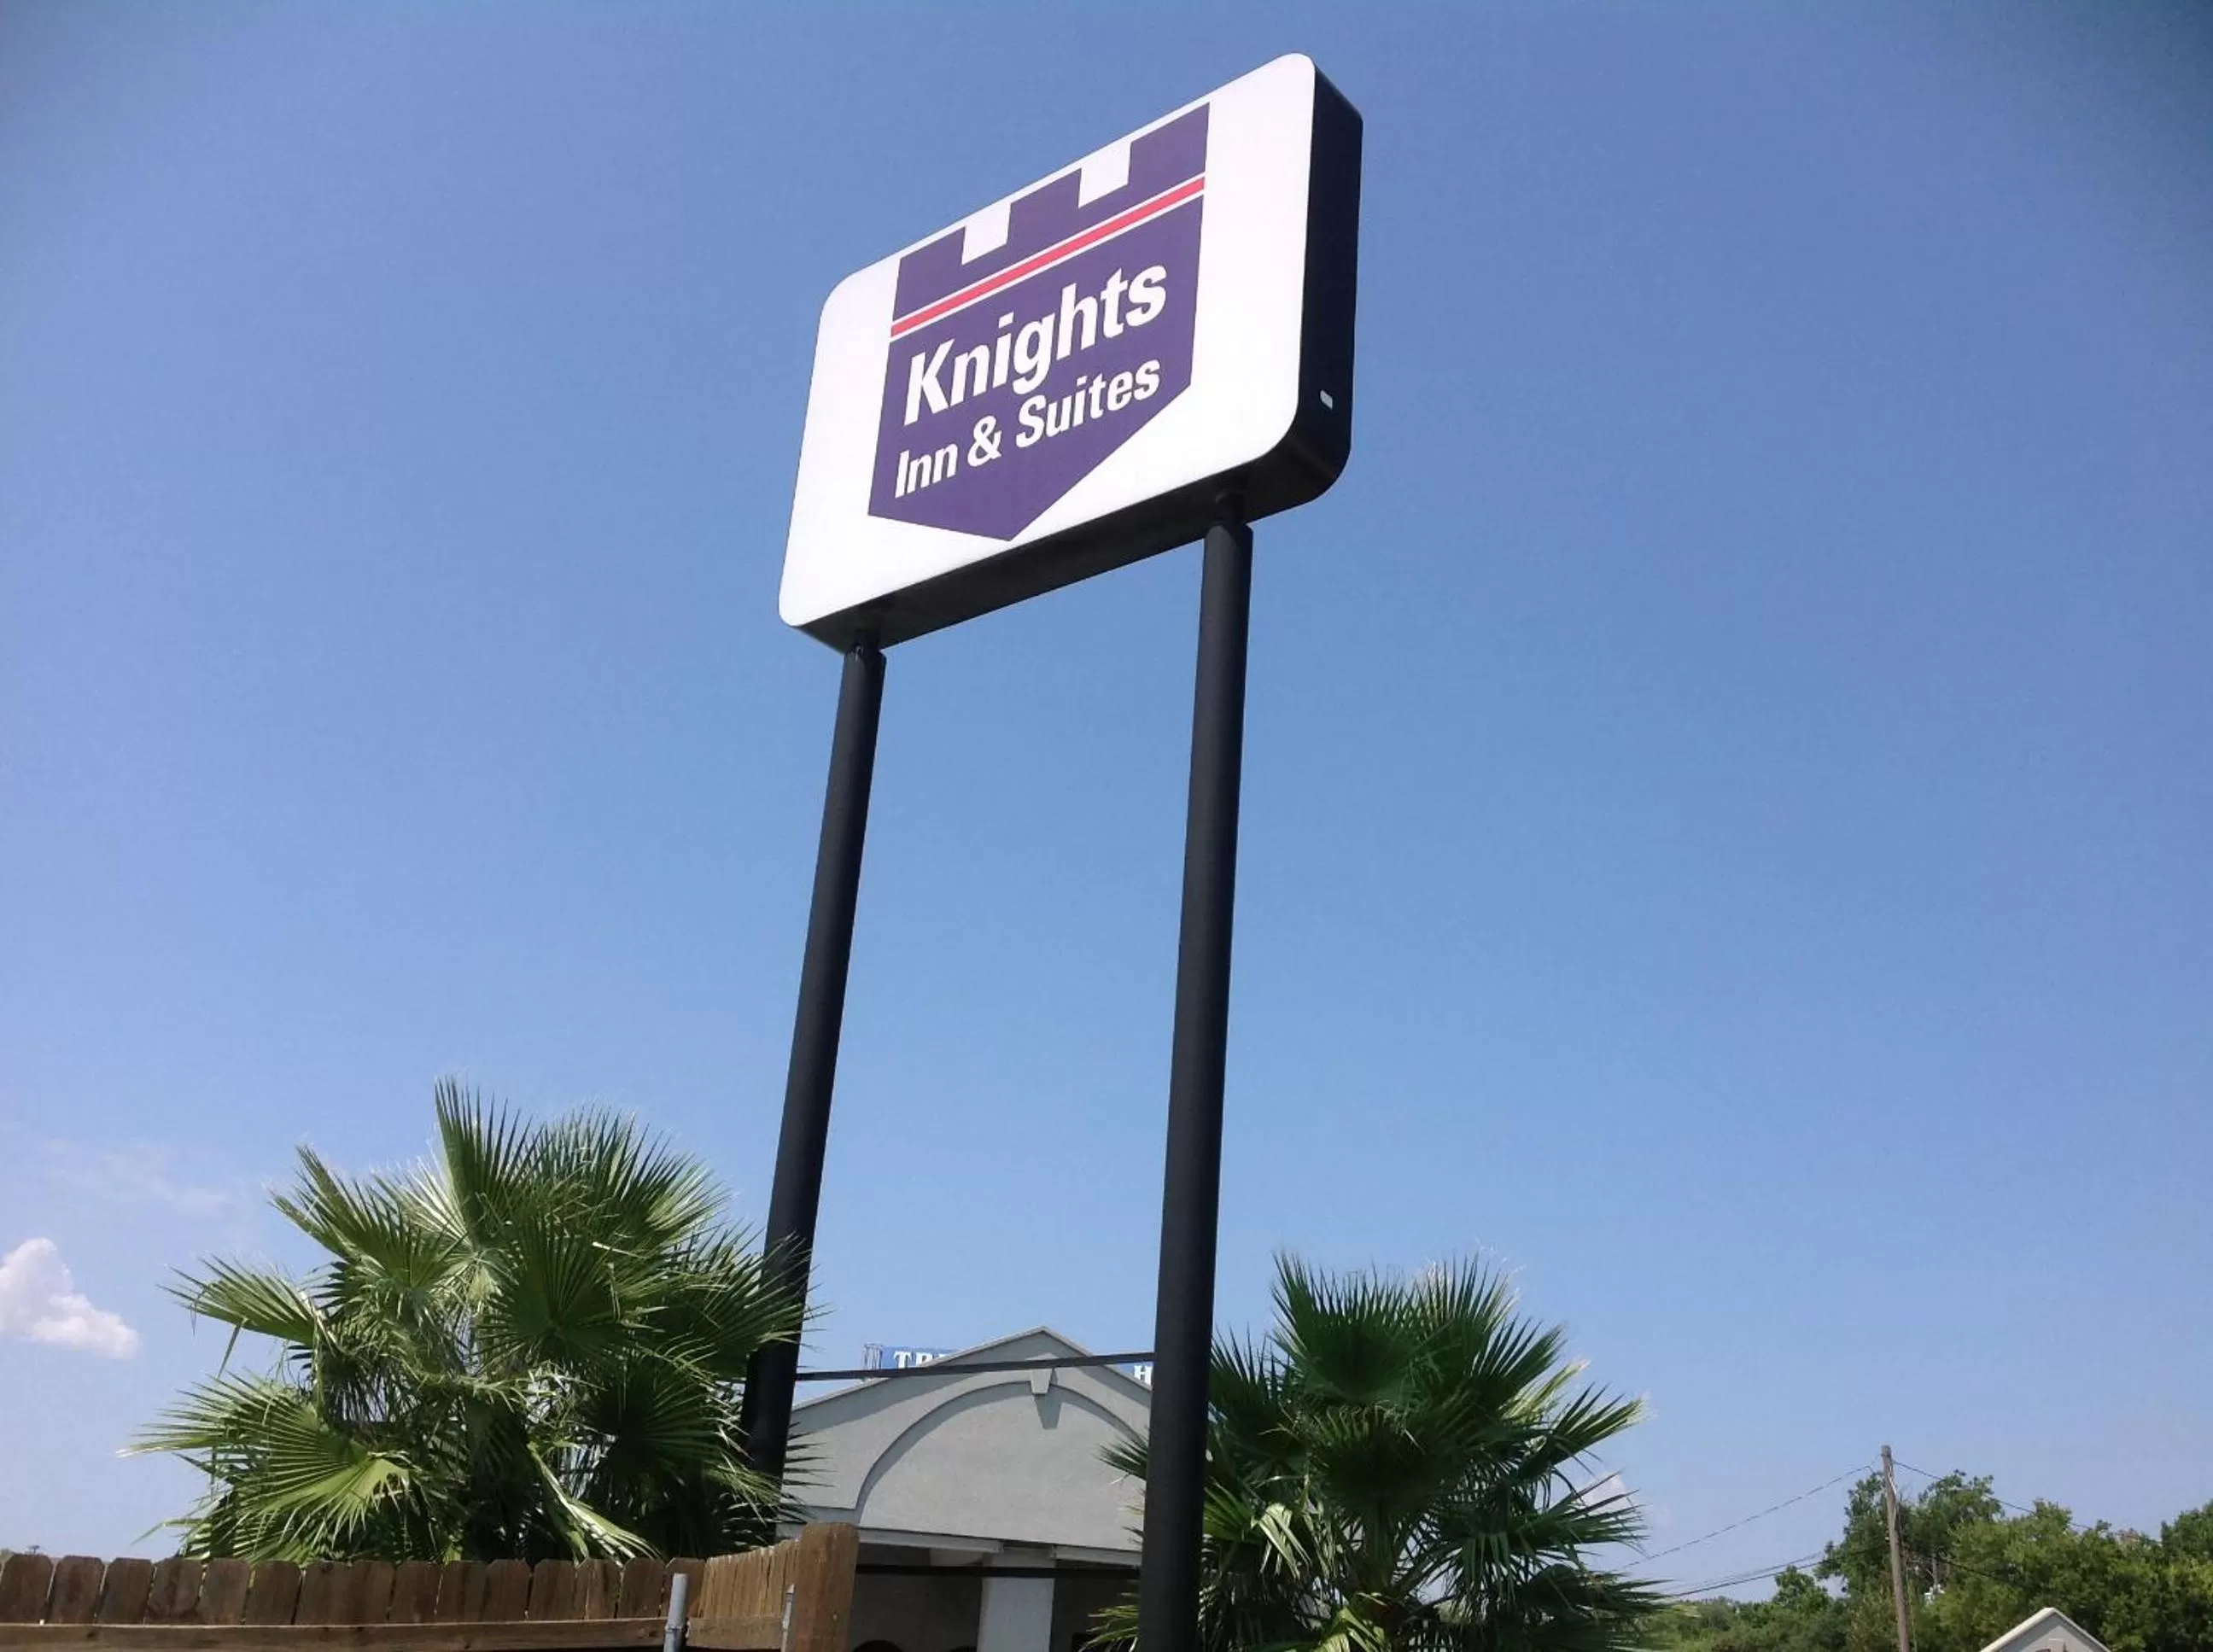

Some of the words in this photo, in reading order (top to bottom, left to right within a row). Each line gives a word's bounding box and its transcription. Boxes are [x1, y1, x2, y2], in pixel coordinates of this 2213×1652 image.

[904, 265, 1167, 426] Knights
[895, 443, 958, 499] Inn
[967, 415, 1002, 467] &
[1015, 359, 1160, 448] Suites
